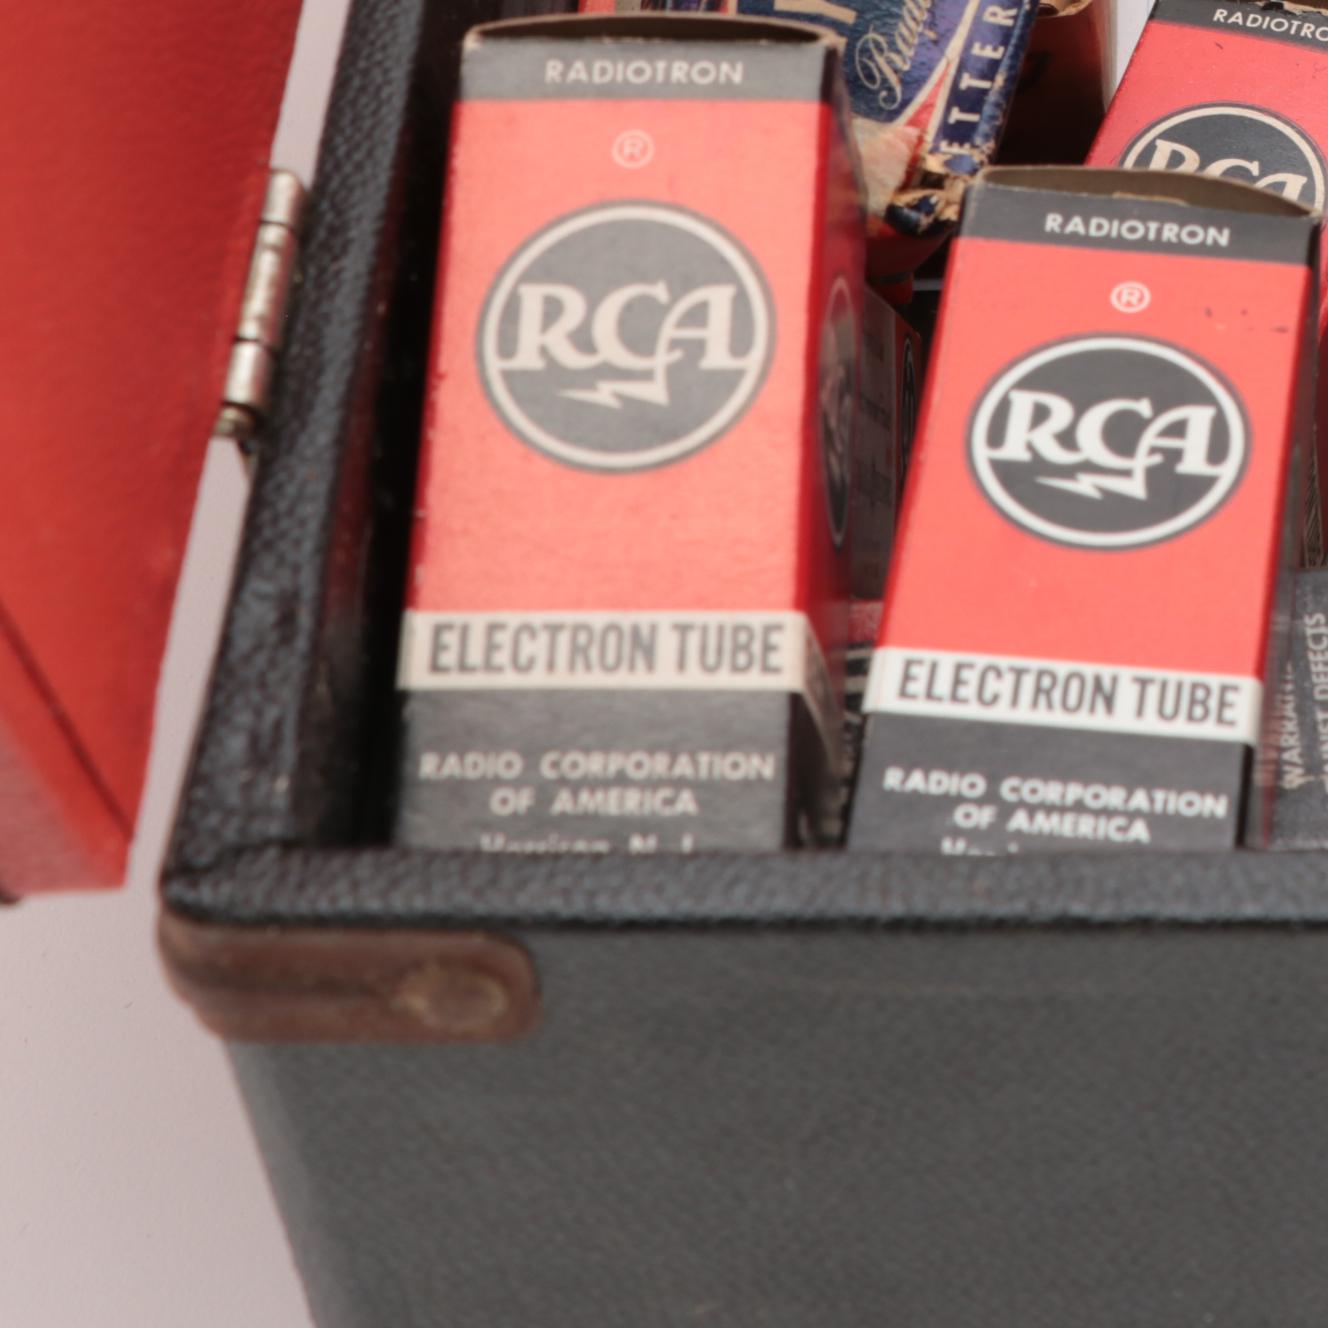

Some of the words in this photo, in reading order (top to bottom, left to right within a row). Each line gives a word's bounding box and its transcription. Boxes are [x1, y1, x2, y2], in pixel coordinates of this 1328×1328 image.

[544, 58, 744, 87] RADIOTRON
[1044, 213, 1231, 248] RADIOTRON
[496, 279, 752, 409] RCA
[985, 389, 1225, 501] RCA
[428, 621, 658, 674] ELECTRON
[672, 621, 785, 674] TUBE
[897, 657, 1120, 717] ELECTRON
[1132, 676, 1240, 727] TUBE
[418, 751, 524, 781] RADIO
[539, 751, 777, 782] CORPORATION
[489, 787, 535, 817] OF
[550, 787, 699, 817] AMERICA
[882, 766, 987, 798] RADIO
[1000, 777, 1229, 818] CORPORATION
[953, 804, 998, 830] OF
[1006, 808, 1152, 844] AMERICA
